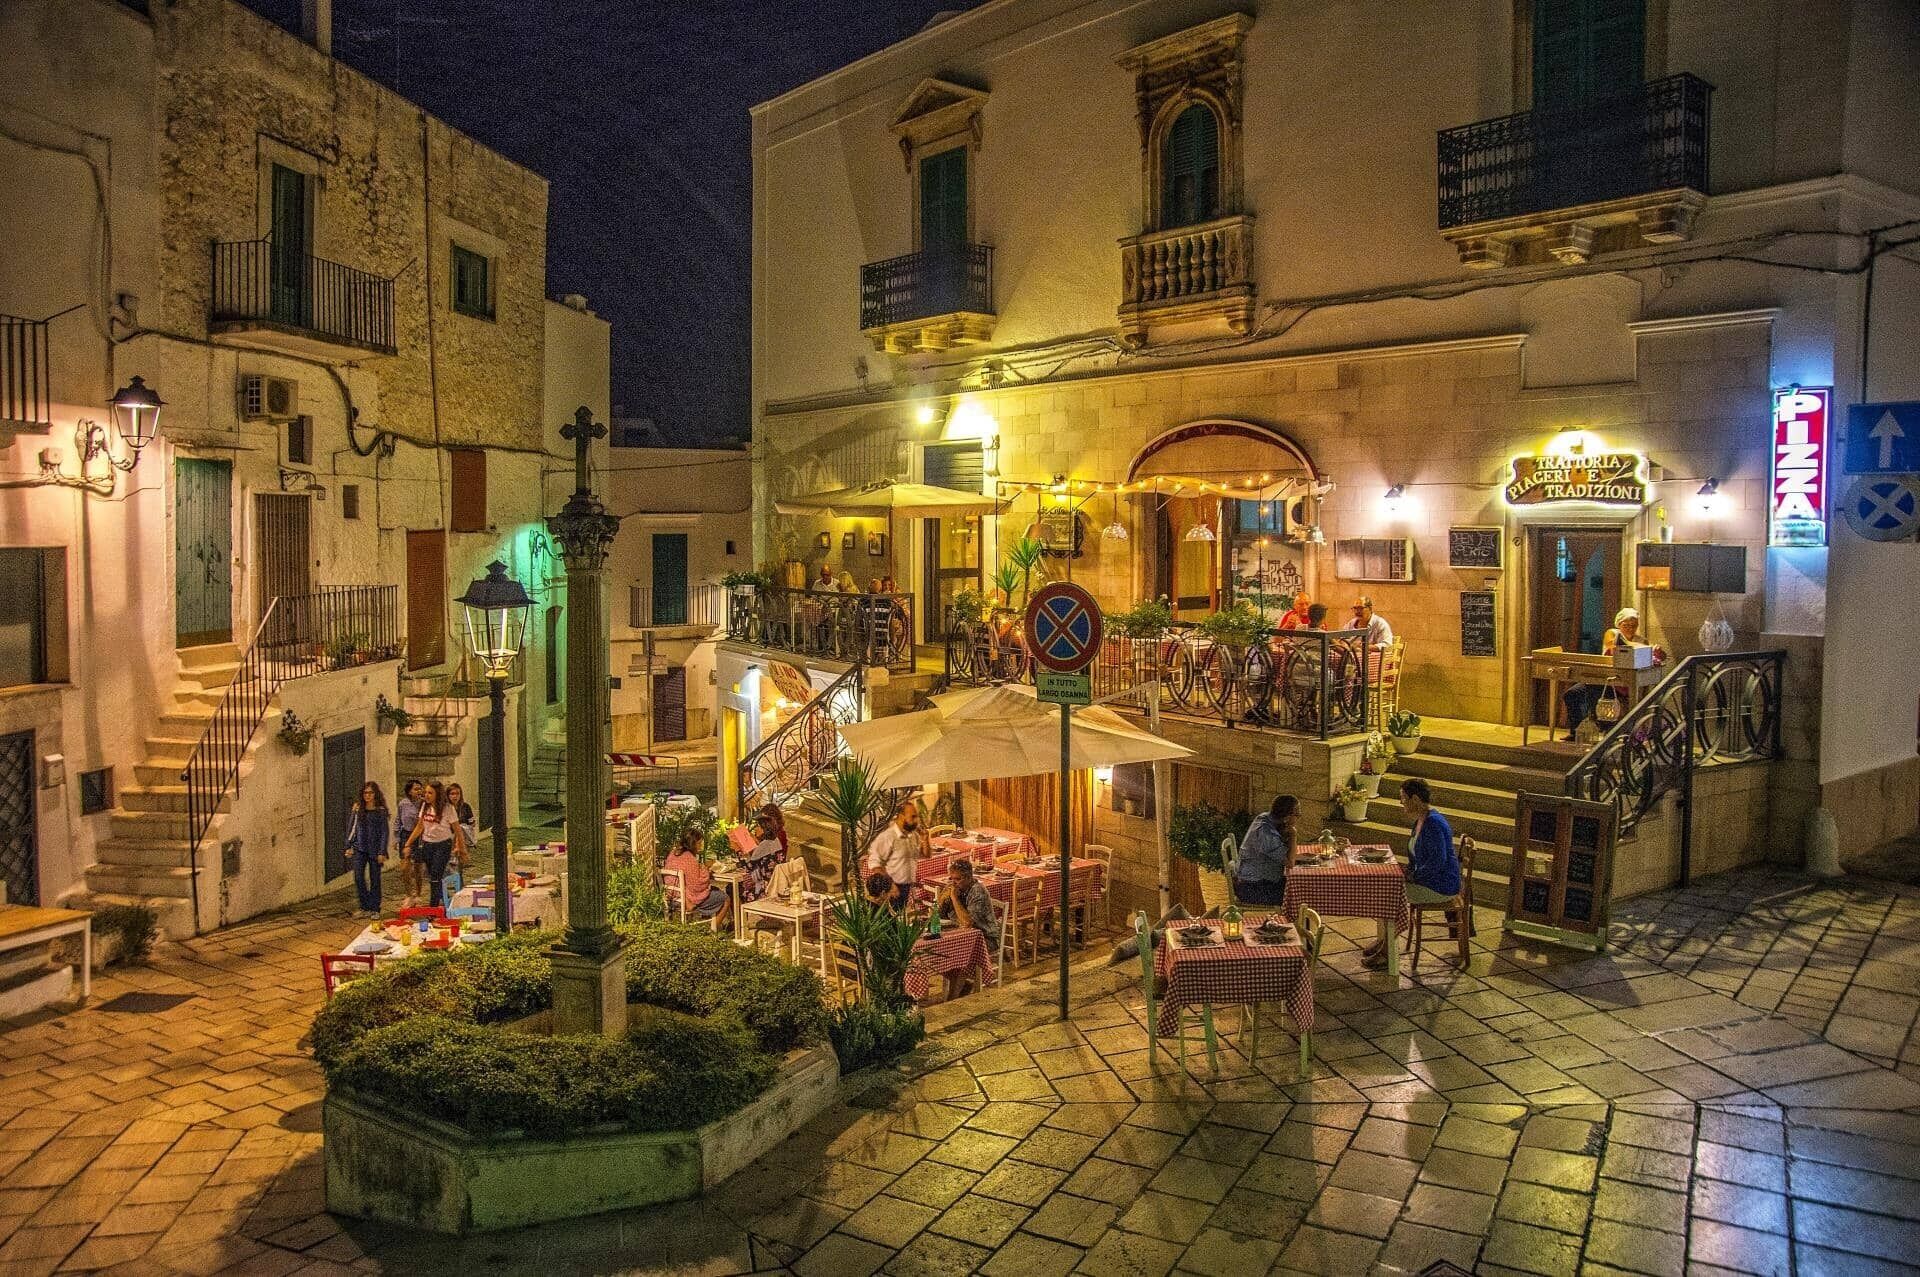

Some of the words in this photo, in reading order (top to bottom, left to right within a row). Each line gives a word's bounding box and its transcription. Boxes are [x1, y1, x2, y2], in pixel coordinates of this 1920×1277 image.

[1536, 455, 1622, 469] TRATTORIA
[1775, 394, 1822, 519] PIZZA
[1508, 469, 1570, 500] PIACERI
[1587, 469, 1599, 482] E
[1545, 485, 1641, 501] TRADIZIONI
[1056, 679, 1077, 687] TUTTO
